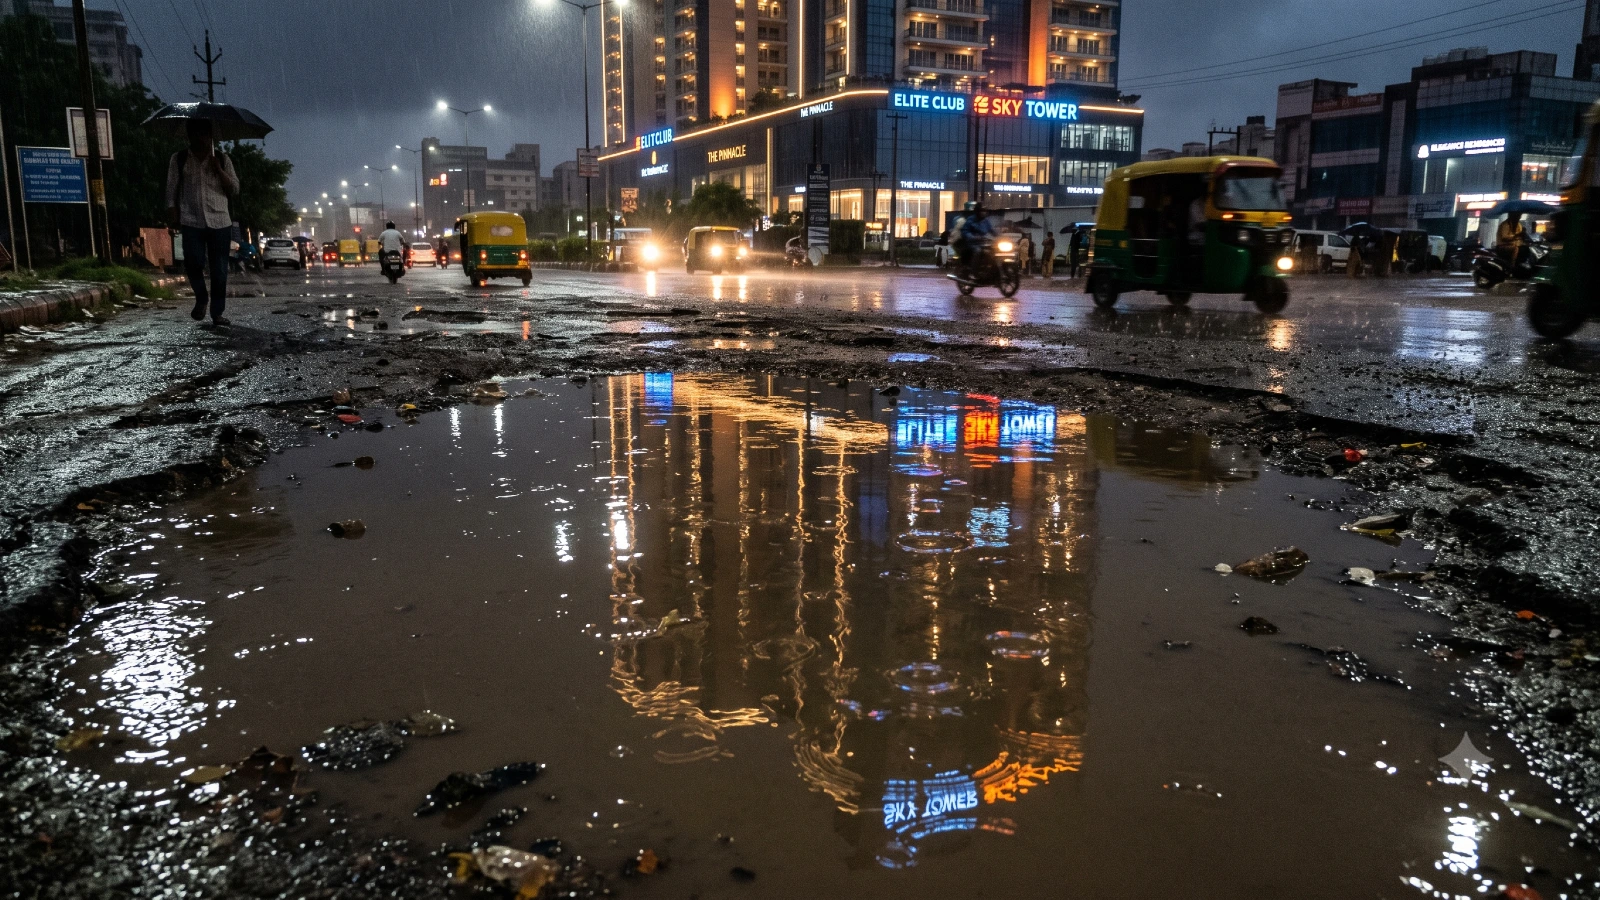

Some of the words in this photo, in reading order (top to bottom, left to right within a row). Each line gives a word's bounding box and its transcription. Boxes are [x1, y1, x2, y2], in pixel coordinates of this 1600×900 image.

[894, 93, 929, 108] ELITE
[932, 96, 965, 111] CLUB
[992, 98, 1022, 116] SKY
[1025, 101, 1077, 120] TOWER
[708, 151, 718, 163] THE
